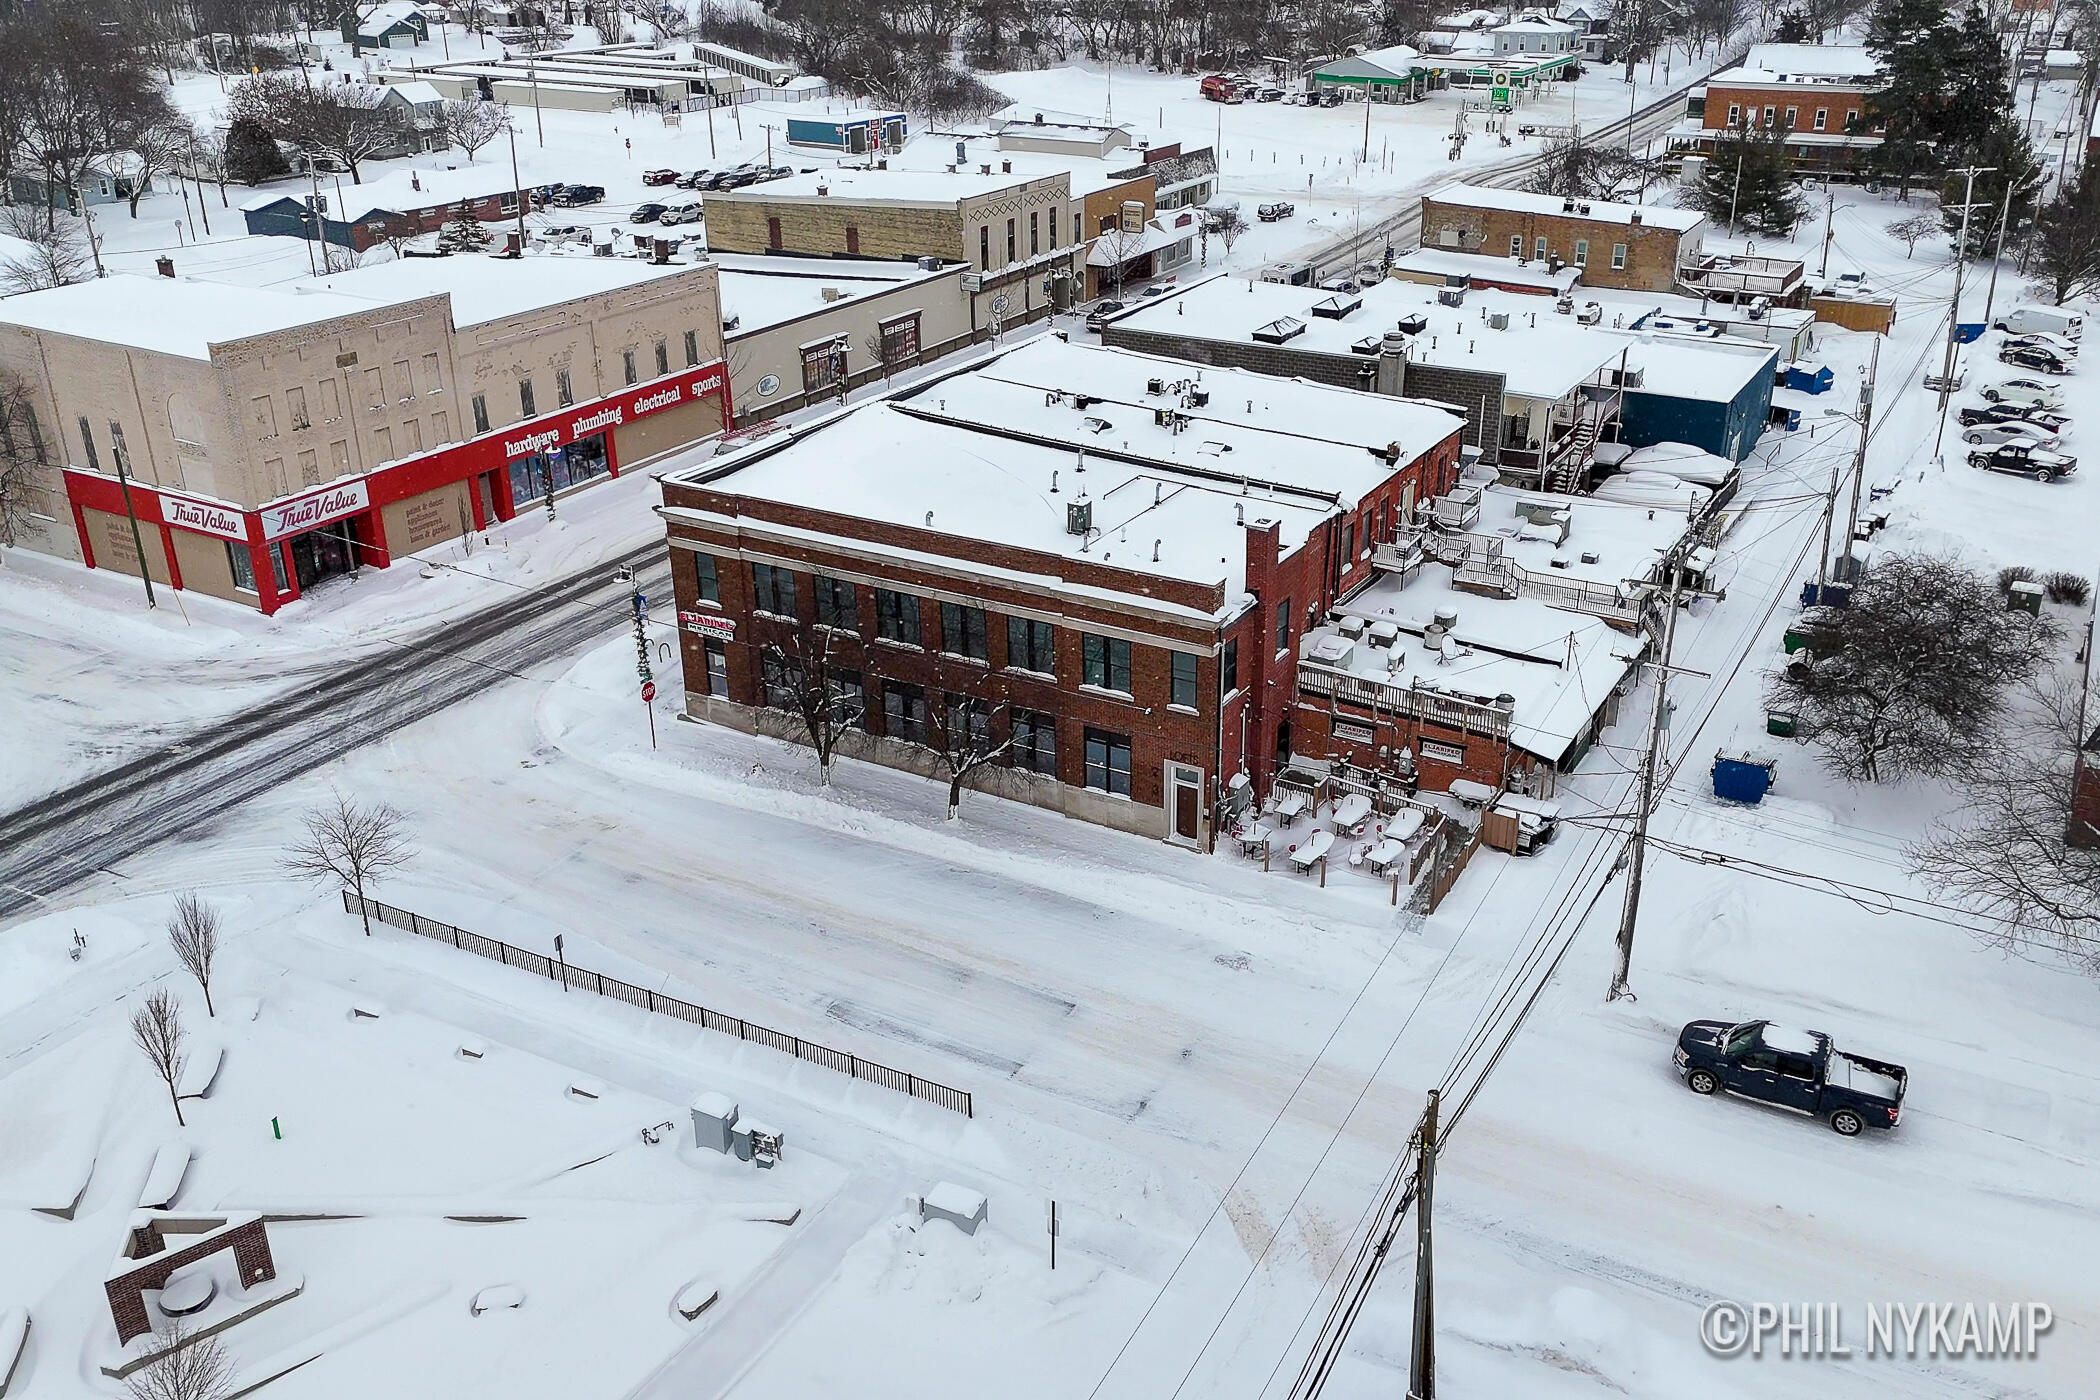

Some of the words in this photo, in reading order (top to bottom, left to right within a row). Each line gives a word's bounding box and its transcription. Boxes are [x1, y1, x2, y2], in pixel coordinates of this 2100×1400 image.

[505, 429, 560, 457] hardware
[572, 406, 623, 439] plumbing
[634, 386, 681, 414] electrical
[692, 375, 721, 397] sports
[689, 624, 732, 638] MEXICAN
[642, 685, 654, 698] STOP
